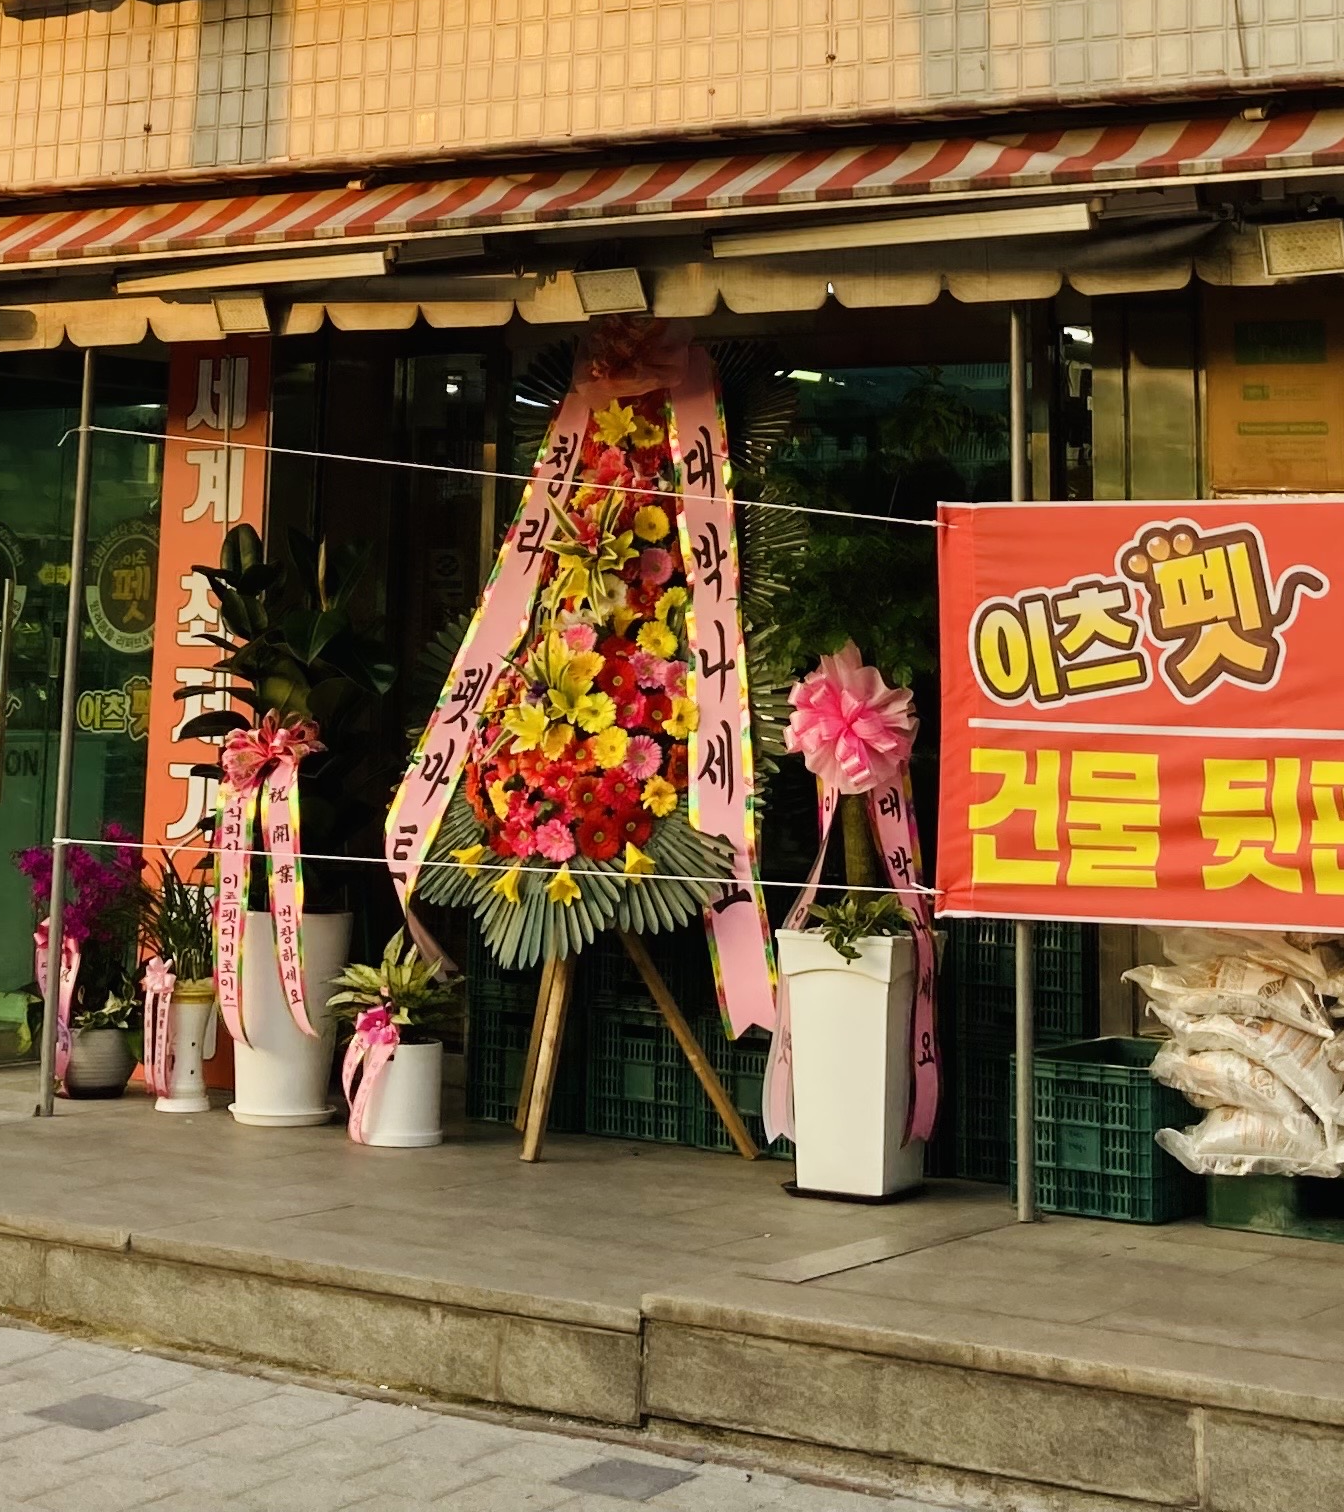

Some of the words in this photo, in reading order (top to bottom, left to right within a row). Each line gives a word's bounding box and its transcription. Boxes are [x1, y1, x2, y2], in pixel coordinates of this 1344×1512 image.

[181, 354, 249, 524] 세계
[971, 526, 1288, 708] 이츠펫
[968, 747, 1161, 888] 건물
